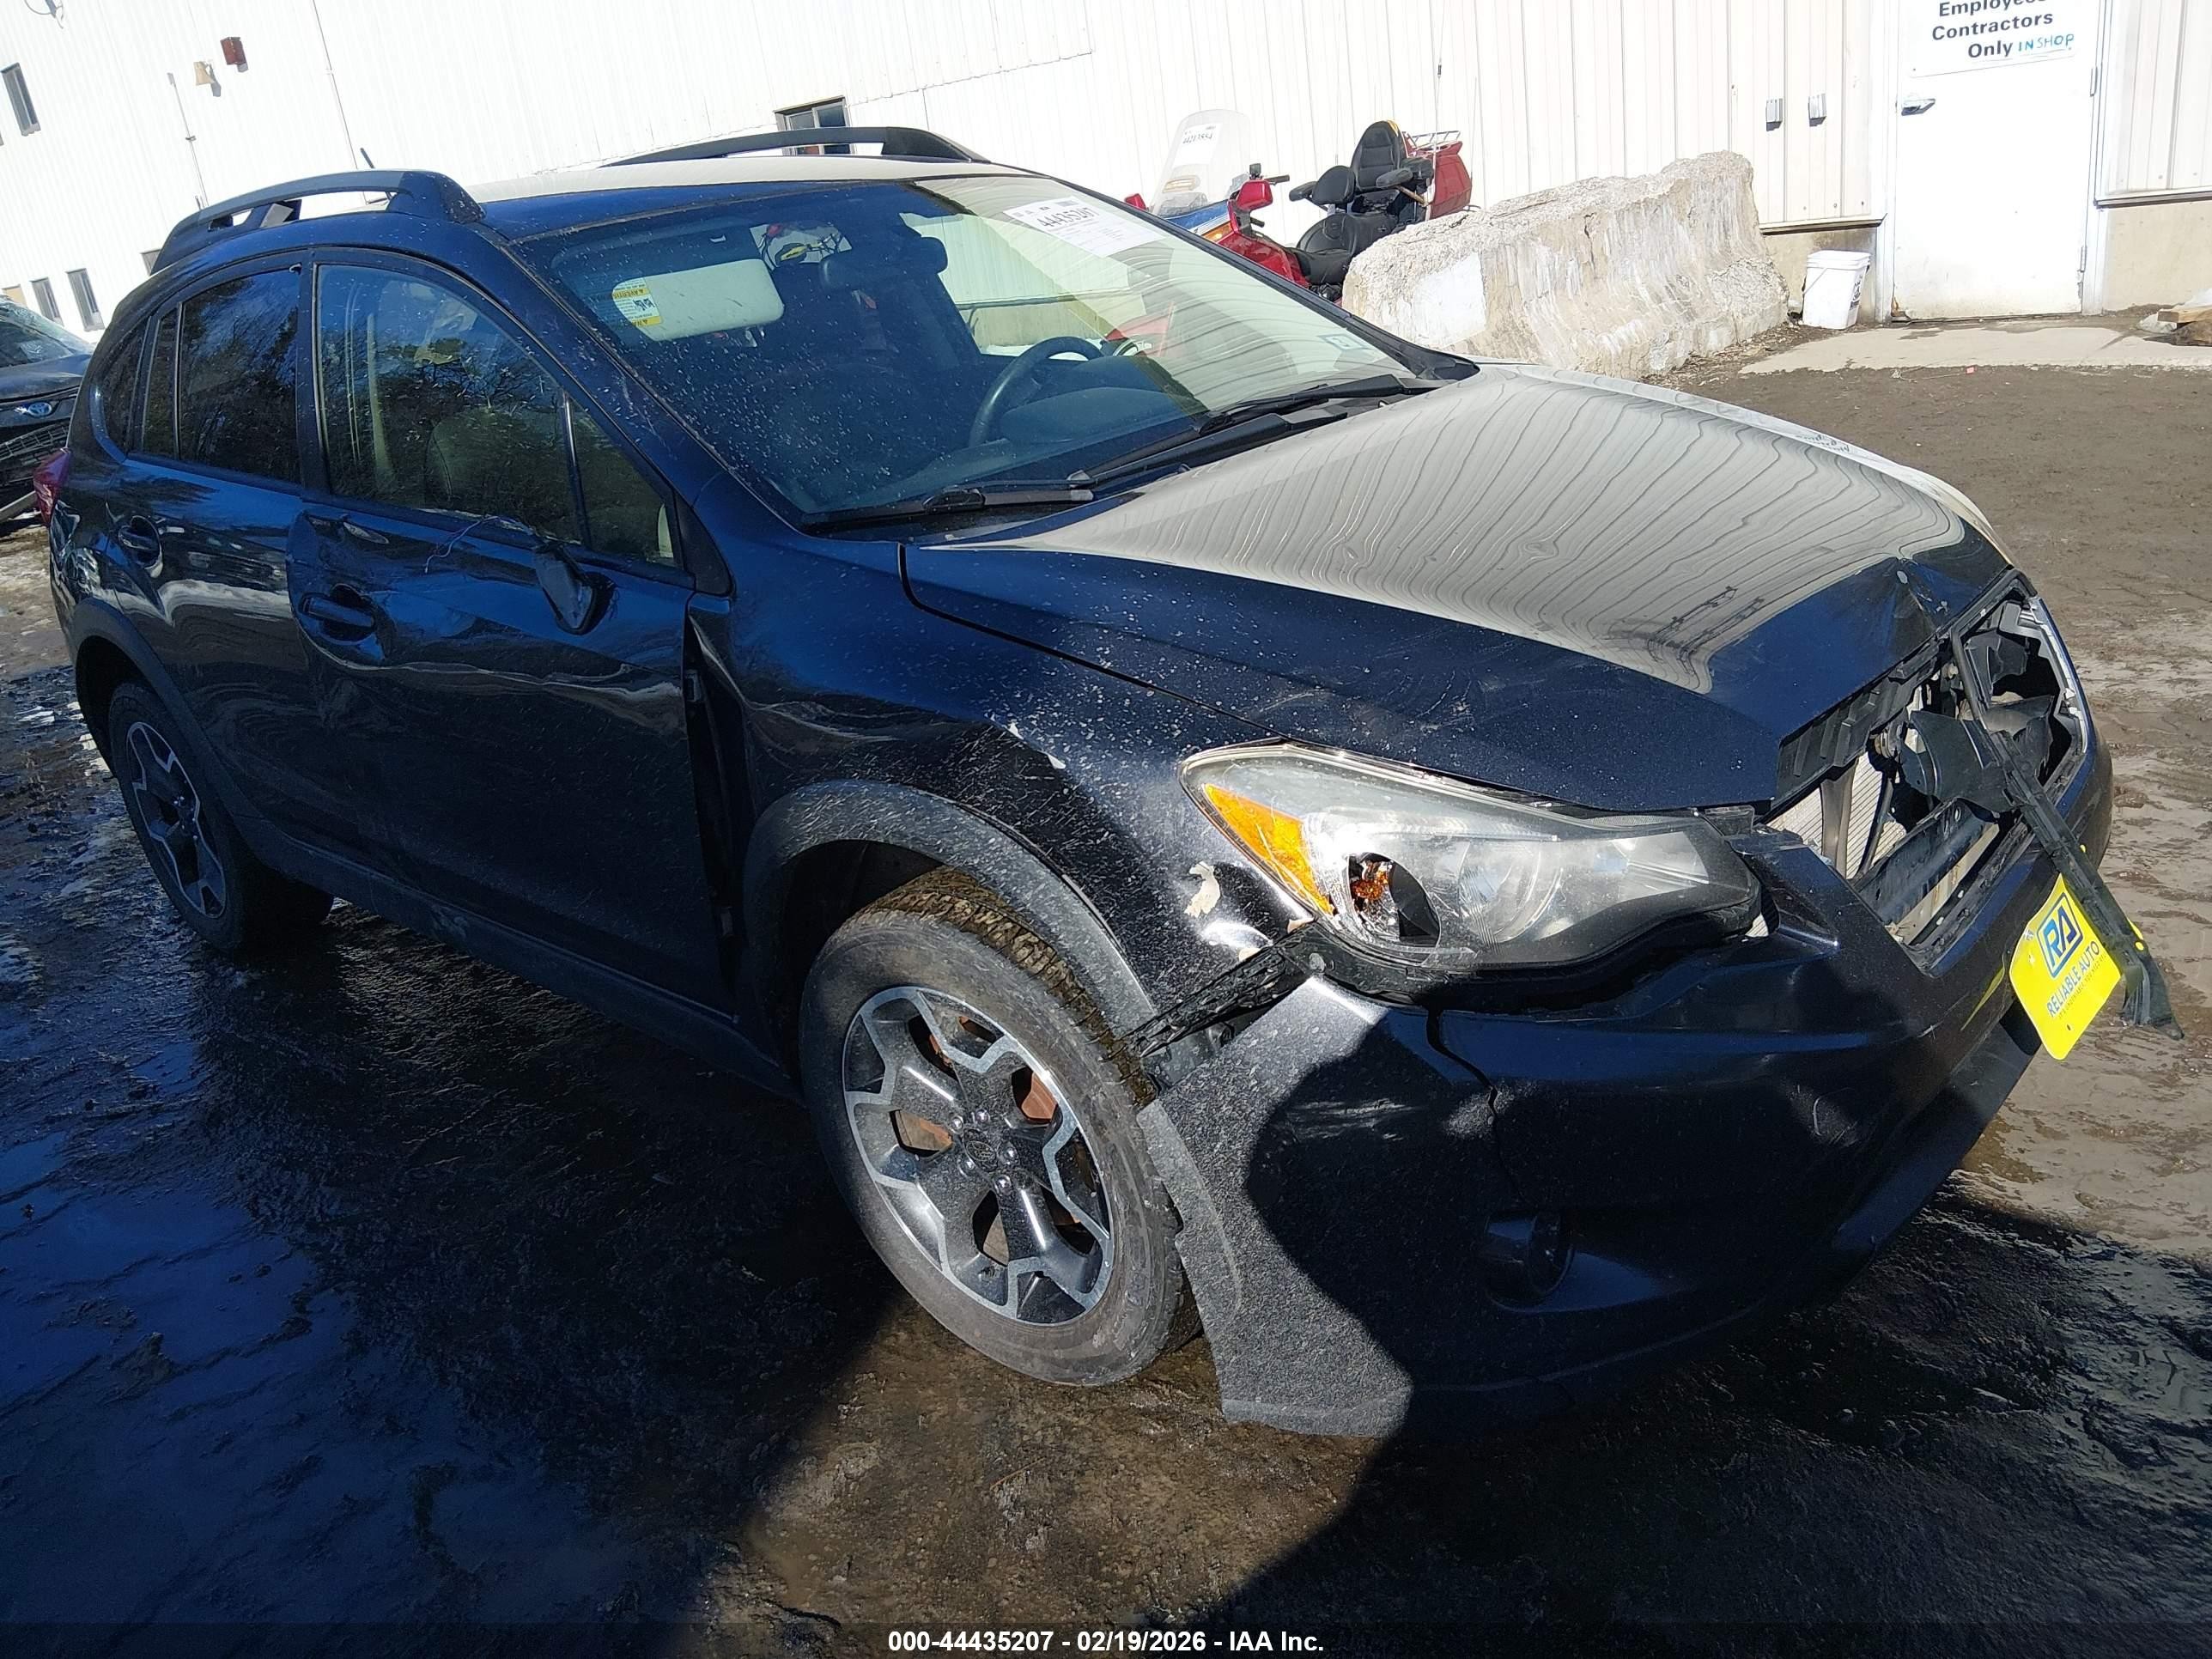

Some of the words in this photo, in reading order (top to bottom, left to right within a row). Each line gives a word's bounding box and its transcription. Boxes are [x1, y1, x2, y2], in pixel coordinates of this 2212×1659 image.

[1939, 0, 2047, 16] Employ
[1932, 13, 2053, 40] Contractors
[1968, 40, 2013, 58] Only
[2043, 907, 2077, 967] RA
[2047, 966, 2081, 1017] RELIABLE
[2079, 941, 2100, 975] AUTO
